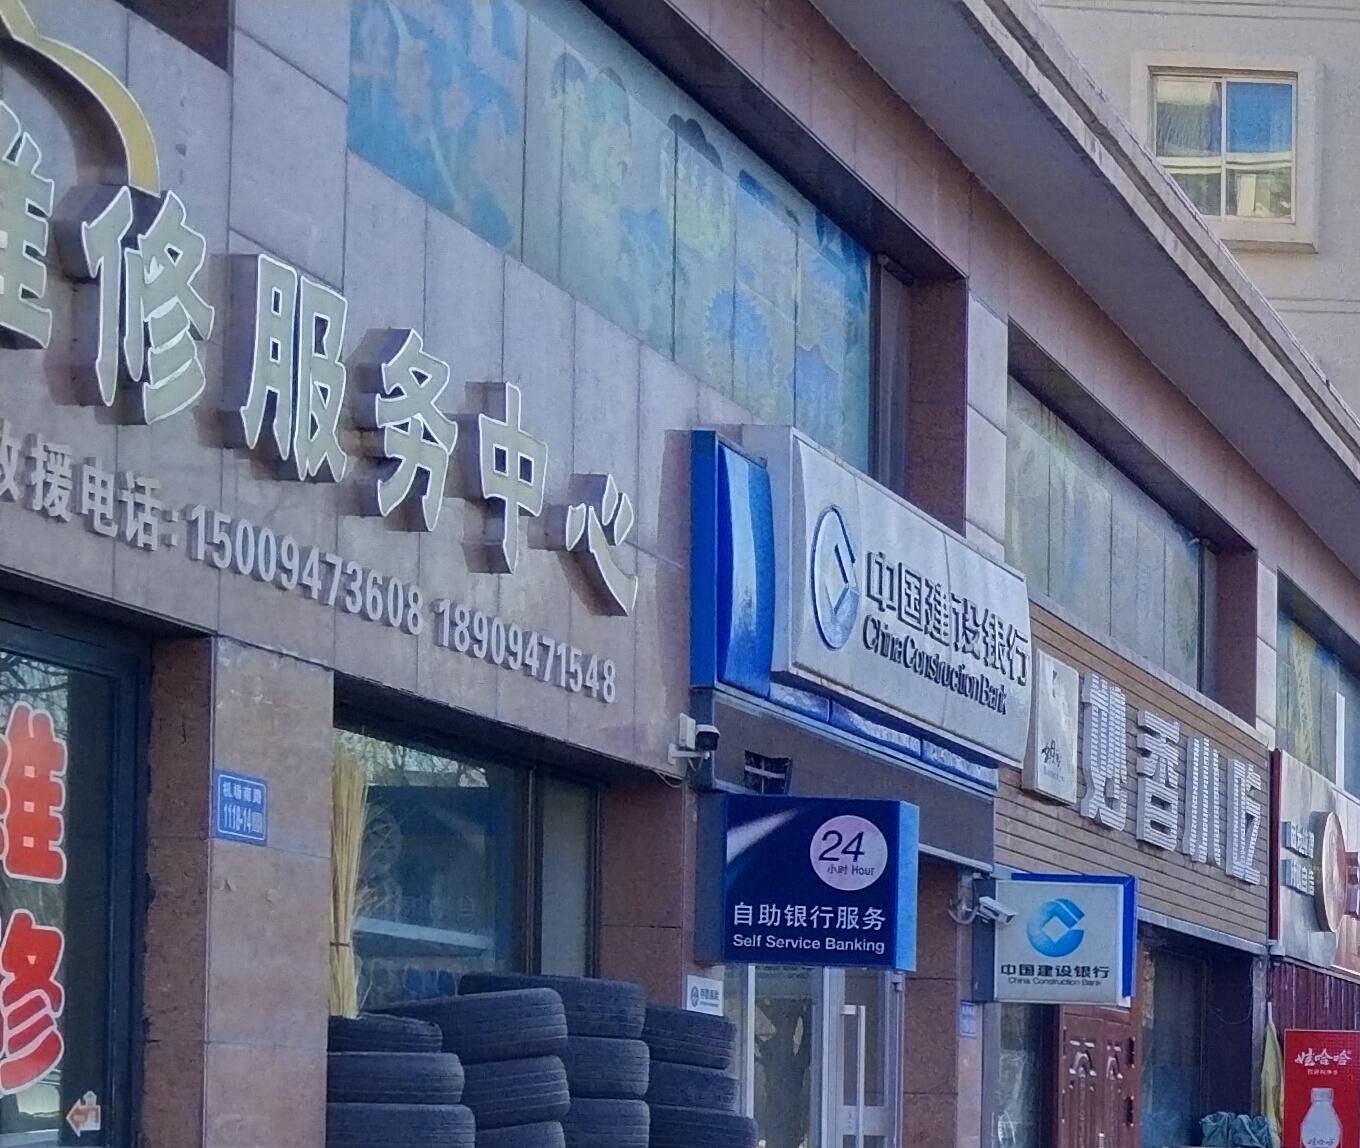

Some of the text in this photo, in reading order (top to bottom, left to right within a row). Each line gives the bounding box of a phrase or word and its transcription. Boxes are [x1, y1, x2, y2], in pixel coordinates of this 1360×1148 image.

[867, 551, 1029, 686] 中国建设银行
[437, 598, 616, 704] 18909471548
[863, 615, 1008, 716] China Construction Bank
[819, 830, 865, 862] 24
[827, 864, 876, 876] 小时 Hour
[733, 902, 886, 931] 自助银行服务
[733, 934, 885, 955] Self Service Banking
[1000, 964, 1110, 979] 中国建设银行
[1294, 1047, 1351, 1067] 娃哈哈
